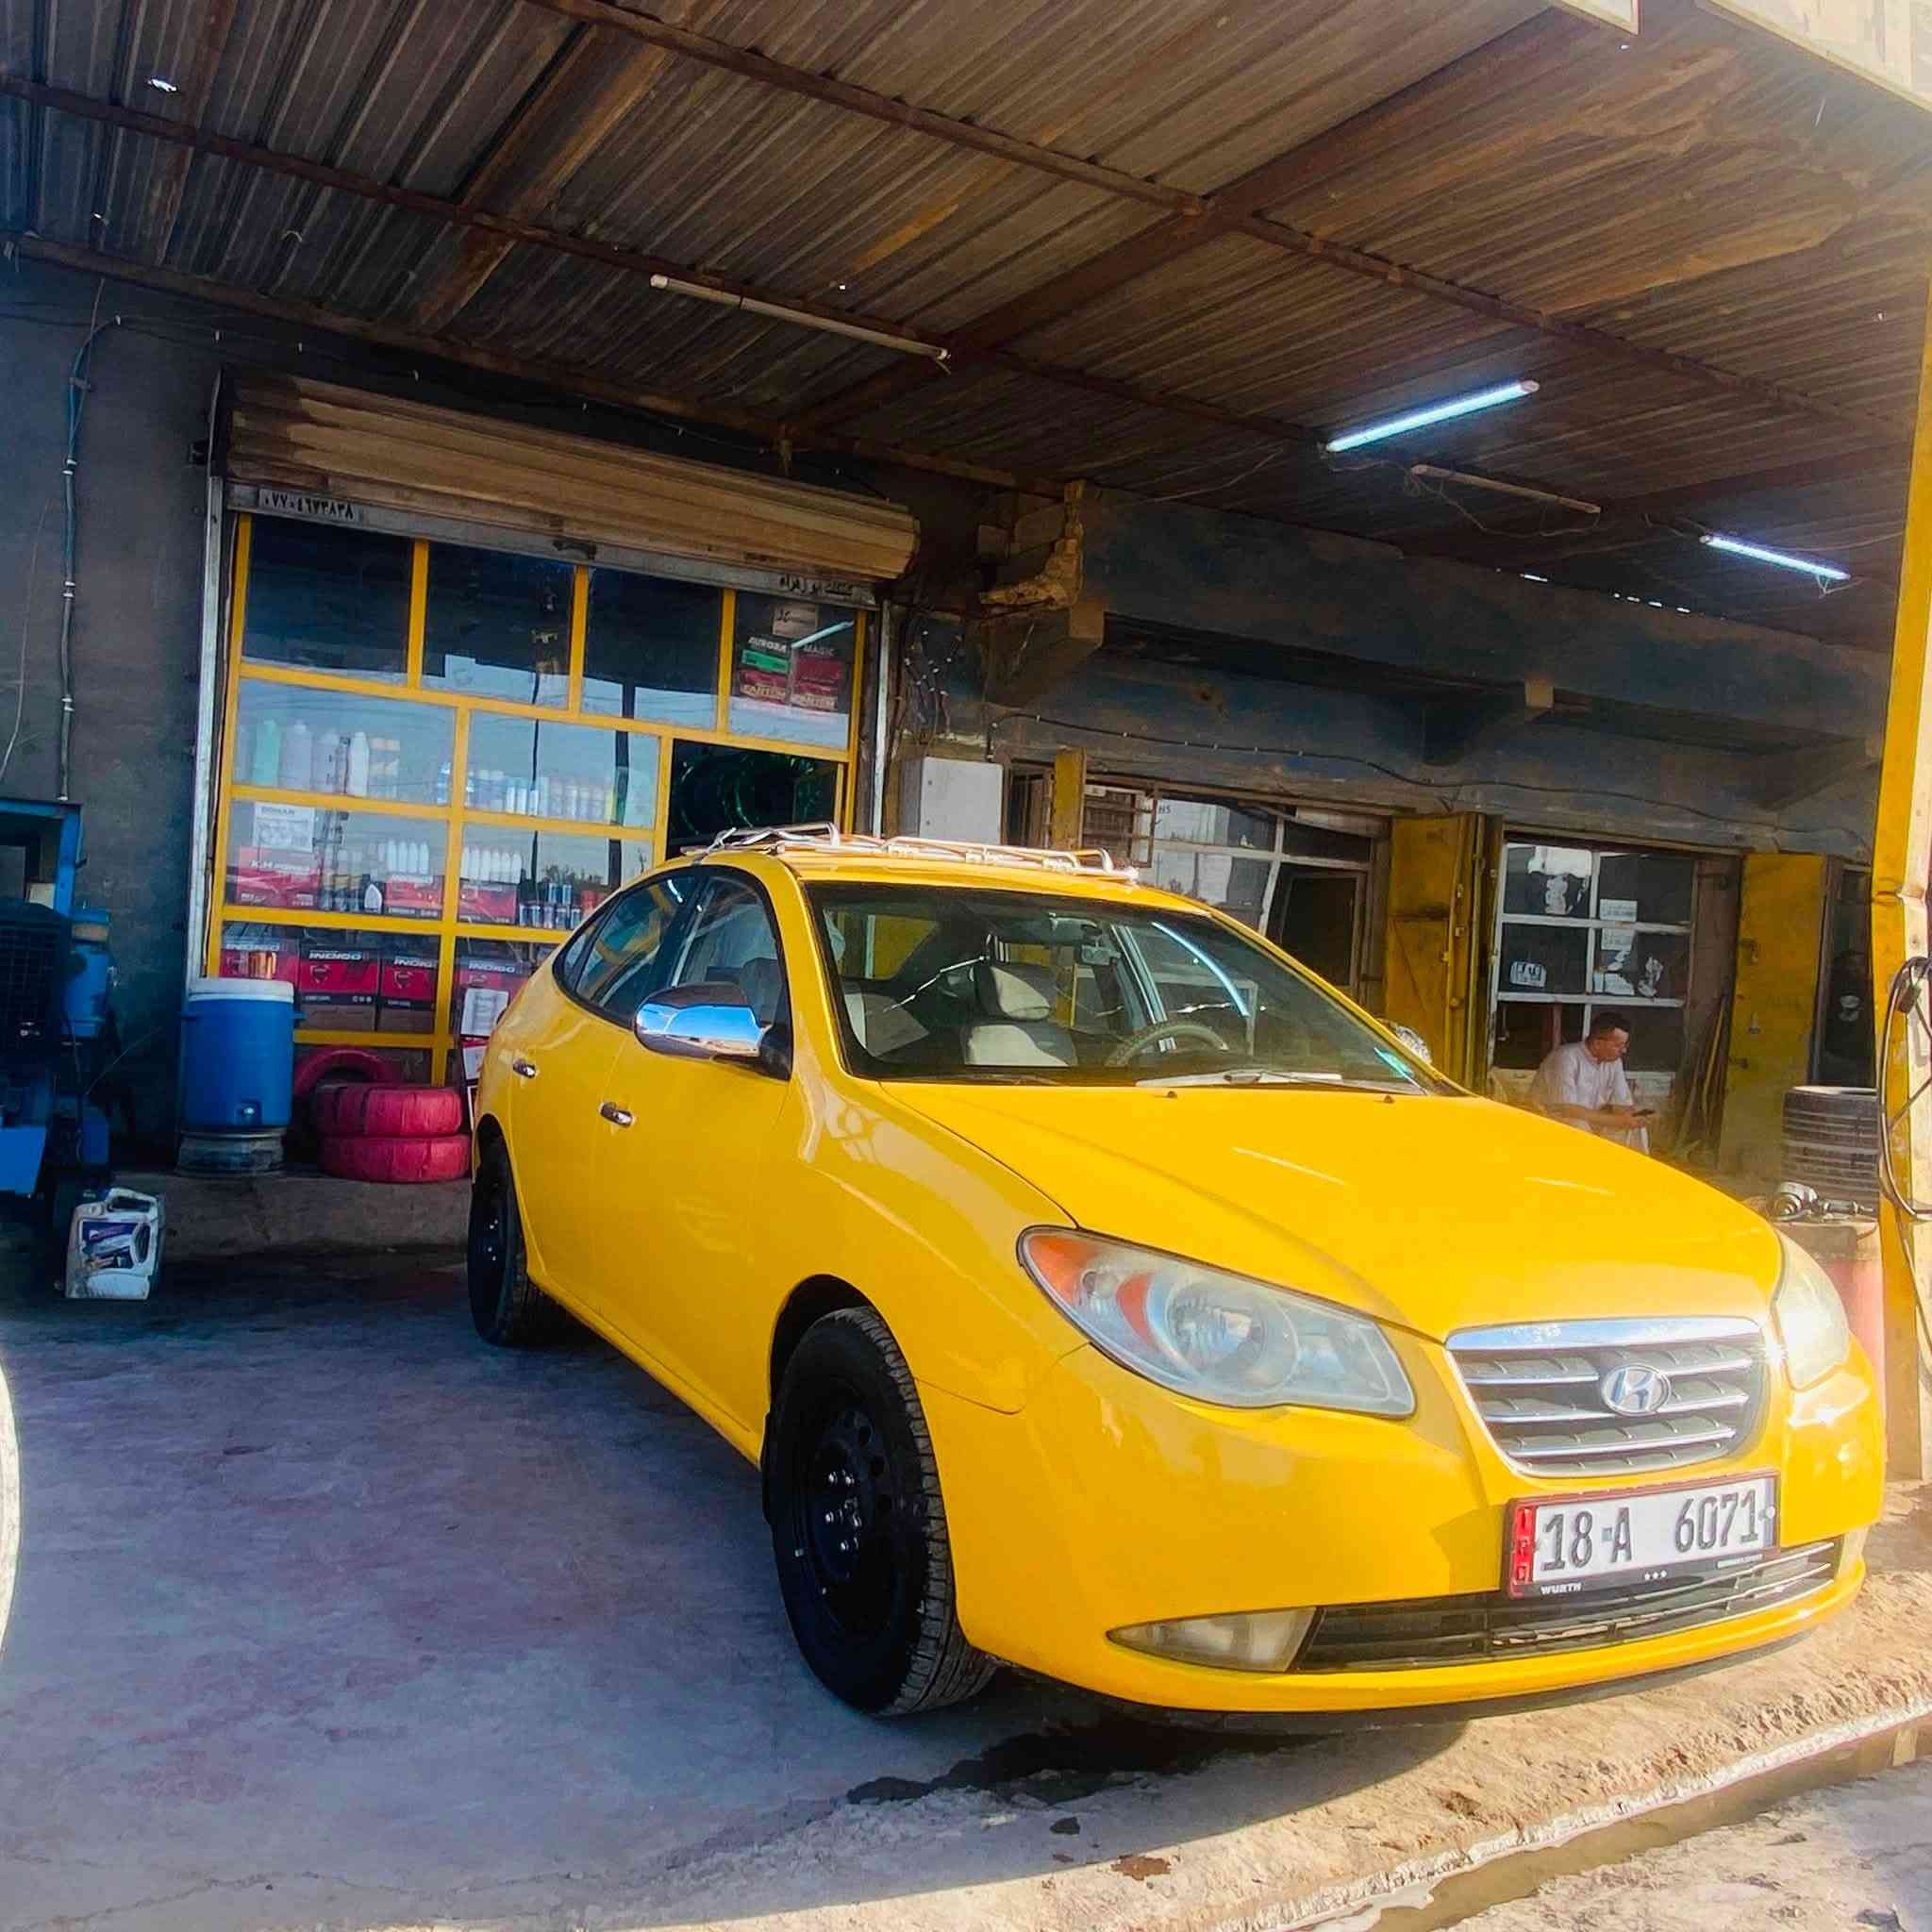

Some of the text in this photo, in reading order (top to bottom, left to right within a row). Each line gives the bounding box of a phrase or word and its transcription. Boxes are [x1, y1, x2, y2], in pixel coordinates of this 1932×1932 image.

[308, 951, 363, 961] INDIGO
[393, 957, 439, 969] INDIG
[468, 960, 516, 974] INDIGO
[1541, 1489, 1759, 1571] 18 A 6071
